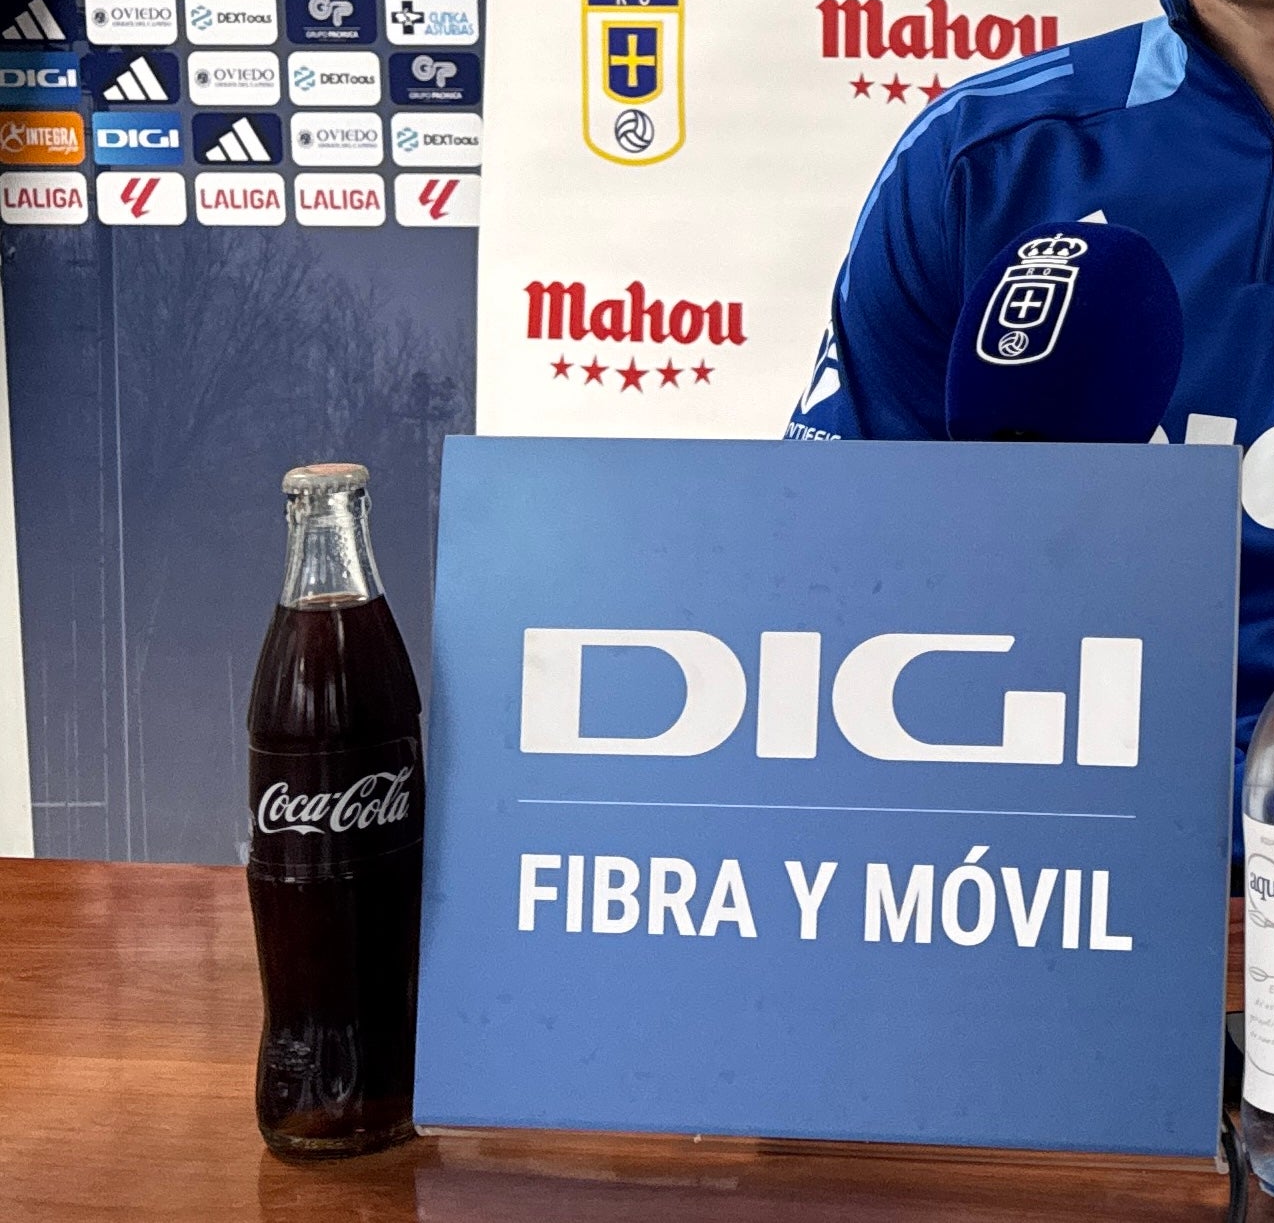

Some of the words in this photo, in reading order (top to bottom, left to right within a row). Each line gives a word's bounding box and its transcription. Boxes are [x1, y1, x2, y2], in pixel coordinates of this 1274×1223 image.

[111, 7, 171, 20] OVIEDO
[0, 69, 77, 88] DIGI
[214, 68, 275, 82] OVIEDO
[26, 129, 77, 146] INTEGRA
[97, 129, 179, 147] DIGI
[317, 129, 377, 142] OVIEDO
[4, 187, 82, 209] LALIGA
[200, 189, 280, 209] LALIGA
[300, 189, 380, 210] LALIGA
[524, 281, 747, 345] Mahou
[520, 628, 1142, 766] DIGI
[258, 767, 412, 835] Coca-Cola
[519, 854, 757, 937] FIBRA
[784, 861, 838, 939] Y
[864, 846, 1132, 950] MÓVIL
